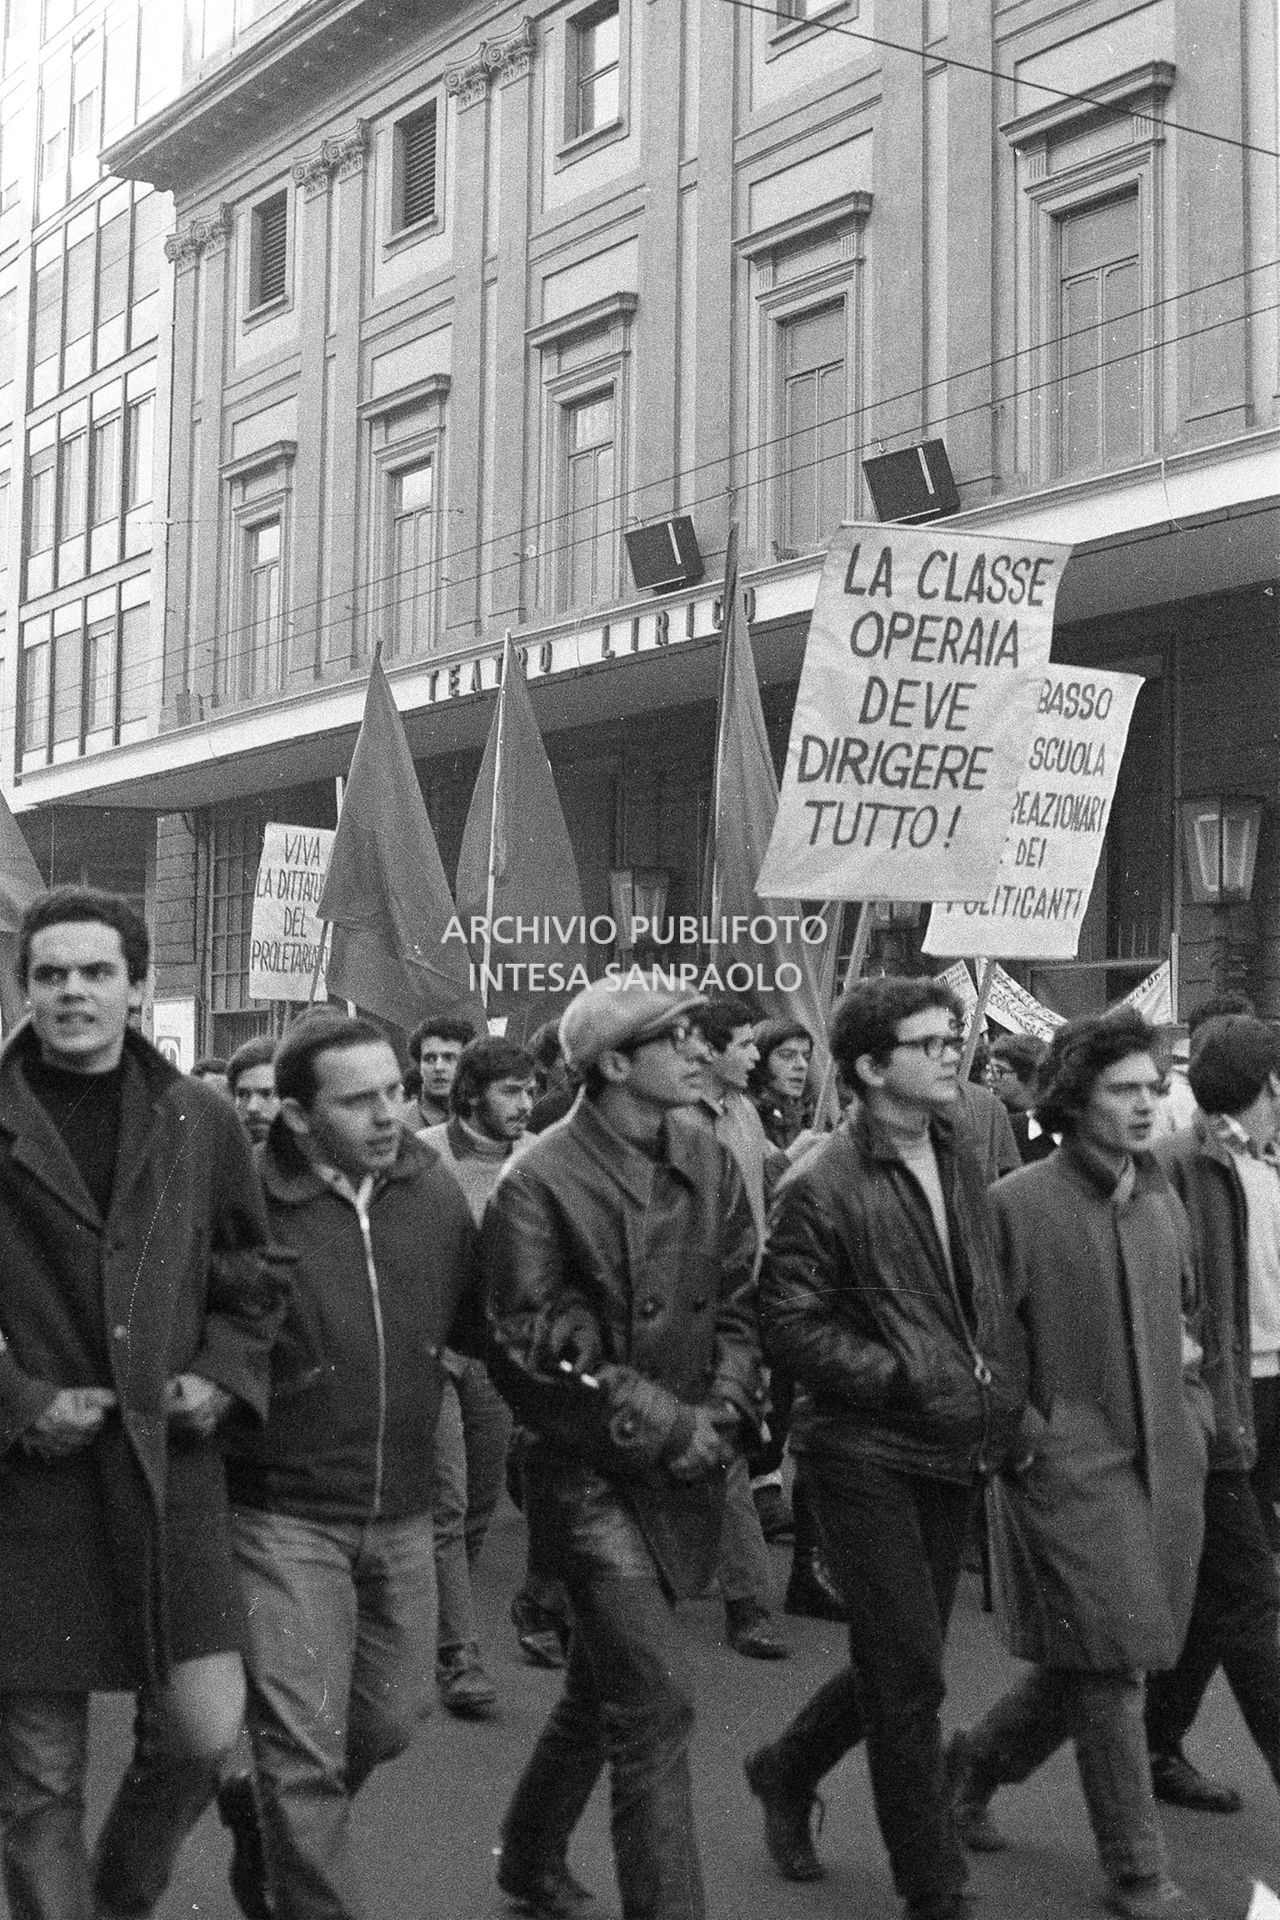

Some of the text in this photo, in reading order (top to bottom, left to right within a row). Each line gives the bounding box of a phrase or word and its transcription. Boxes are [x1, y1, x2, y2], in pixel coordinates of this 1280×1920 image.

[843, 543, 1055, 607] LA CLASSE
[849, 610, 1020, 668] OPERAIA
[858, 675, 978, 732] DEVE
[797, 734, 995, 791] DIRIGERE
[1029, 736, 1106, 776] SCUOLA
[804, 799, 962, 849] TUTTO!
[285, 832, 320, 867] VIVA
[1015, 836, 1047, 868] DEI
[257, 868, 273, 899] LA
[284, 906, 307, 938] DEL
